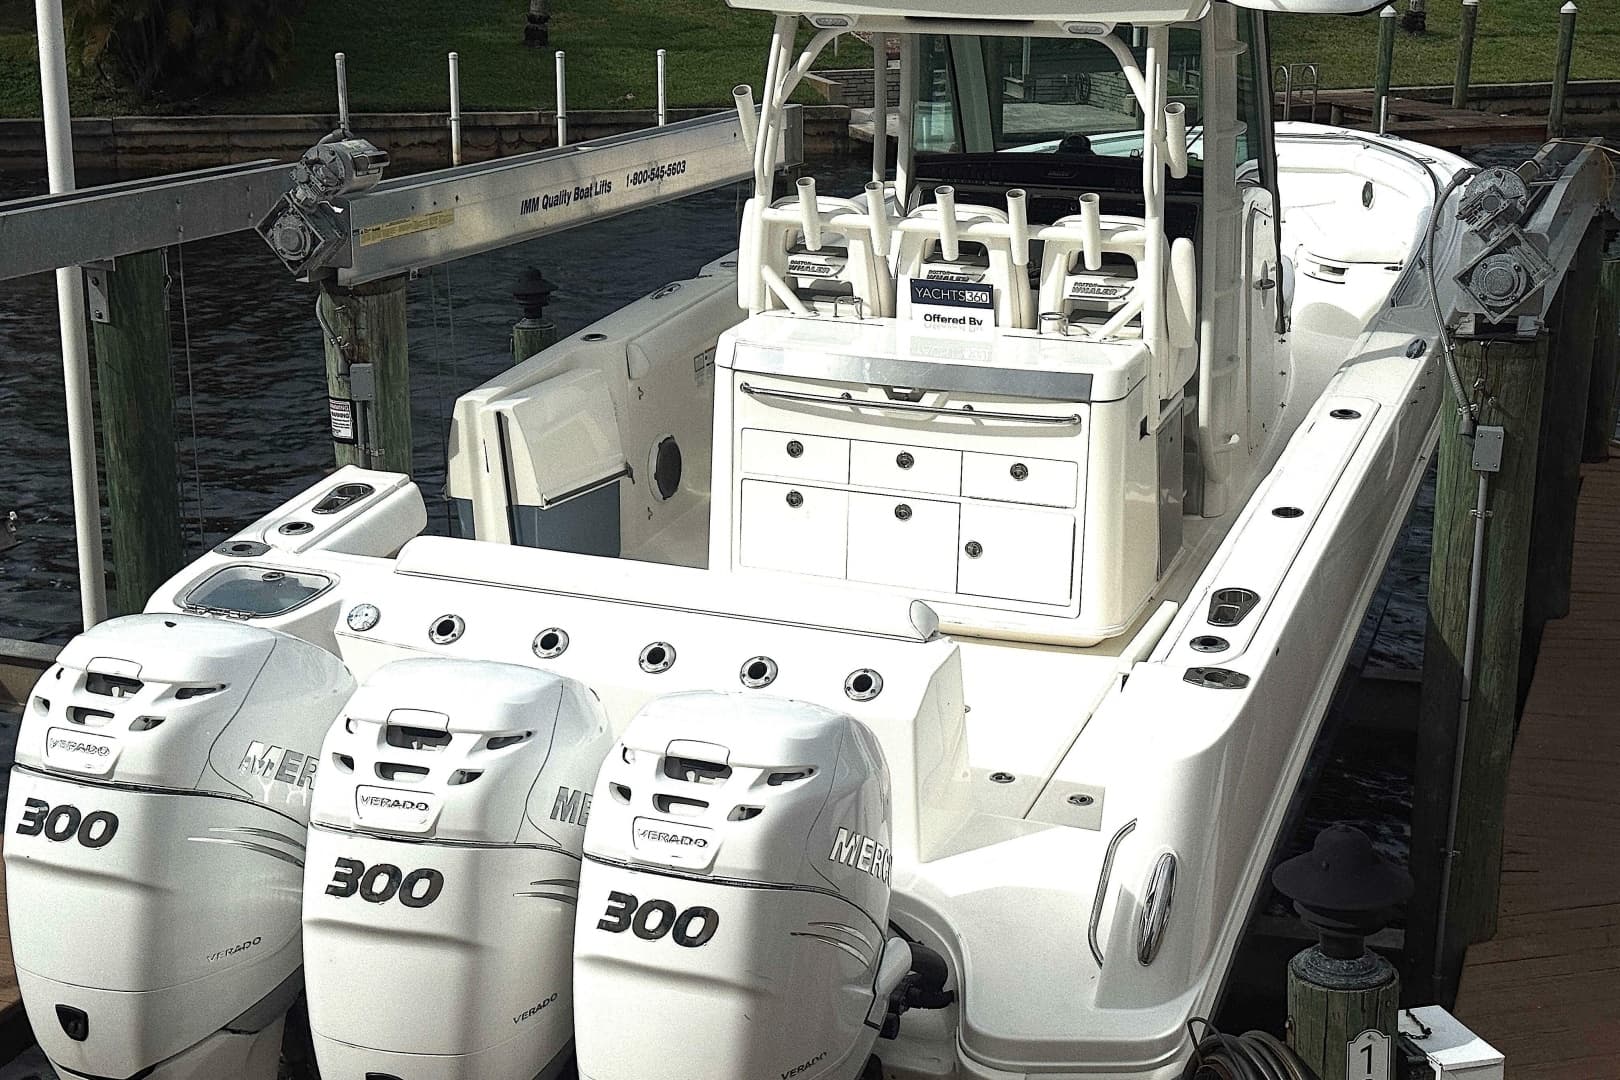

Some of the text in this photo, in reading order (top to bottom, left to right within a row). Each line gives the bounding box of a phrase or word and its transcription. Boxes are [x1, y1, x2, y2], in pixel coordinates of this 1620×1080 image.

[520, 160, 687, 215] IMM Quality Boat Lifts 1-800-545-5603
[923, 313, 966, 325] Offered
[50, 737, 110, 756] VERADO
[360, 795, 430, 811] VERADO
[16, 797, 119, 848] 300
[637, 828, 709, 848] VERADO
[324, 857, 444, 908] 300
[596, 890, 719, 948] 300
[206, 936, 262, 961] VERADO
[513, 993, 558, 1024] VERADO
[781, 1051, 827, 1080] VERADO
